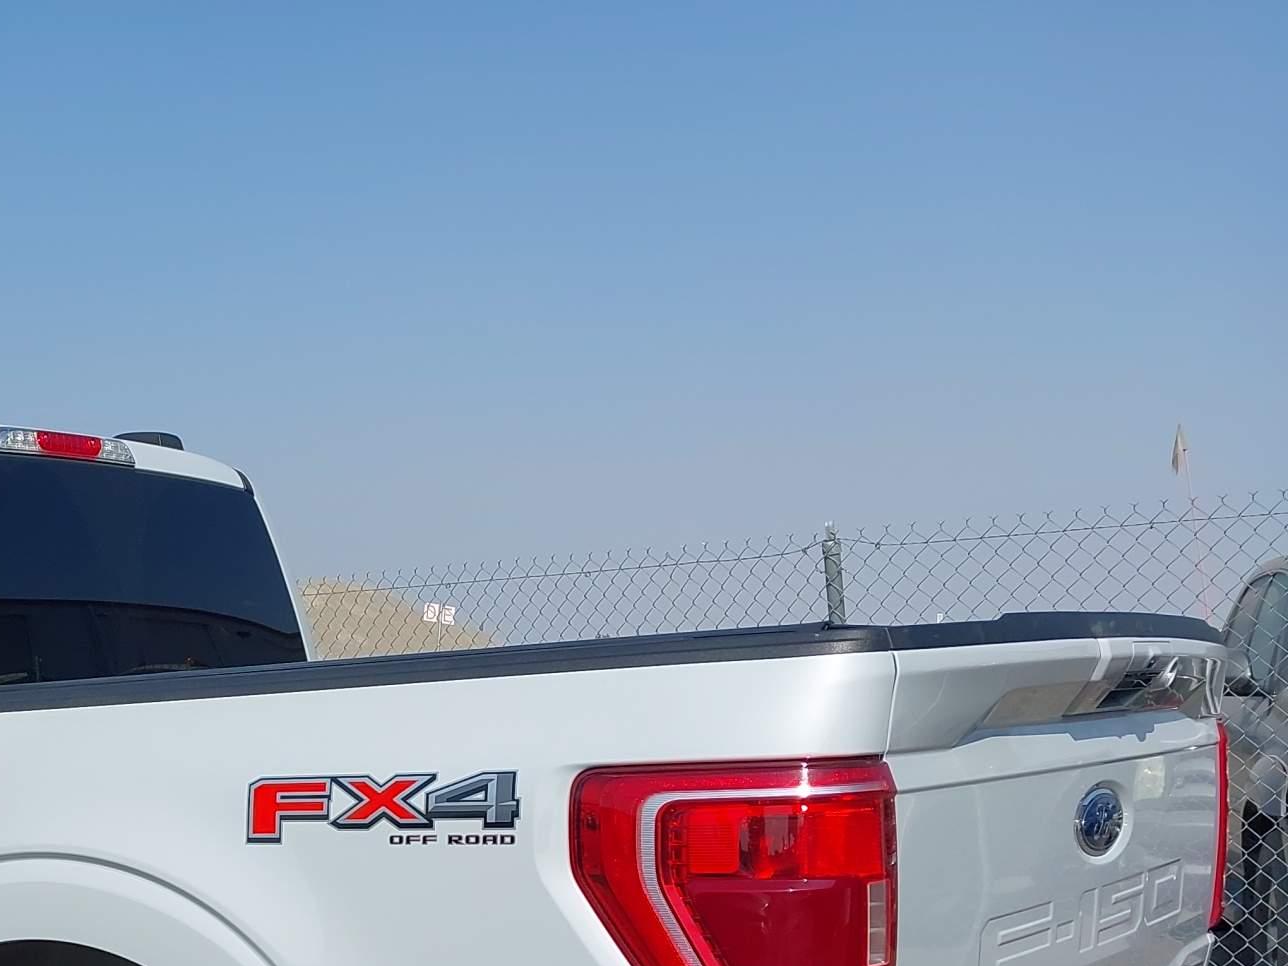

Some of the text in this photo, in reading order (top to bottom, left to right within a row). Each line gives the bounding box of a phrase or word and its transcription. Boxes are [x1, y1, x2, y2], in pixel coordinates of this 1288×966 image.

[246, 771, 521, 844] FX4
[388, 833, 516, 846] OFF ROAD
